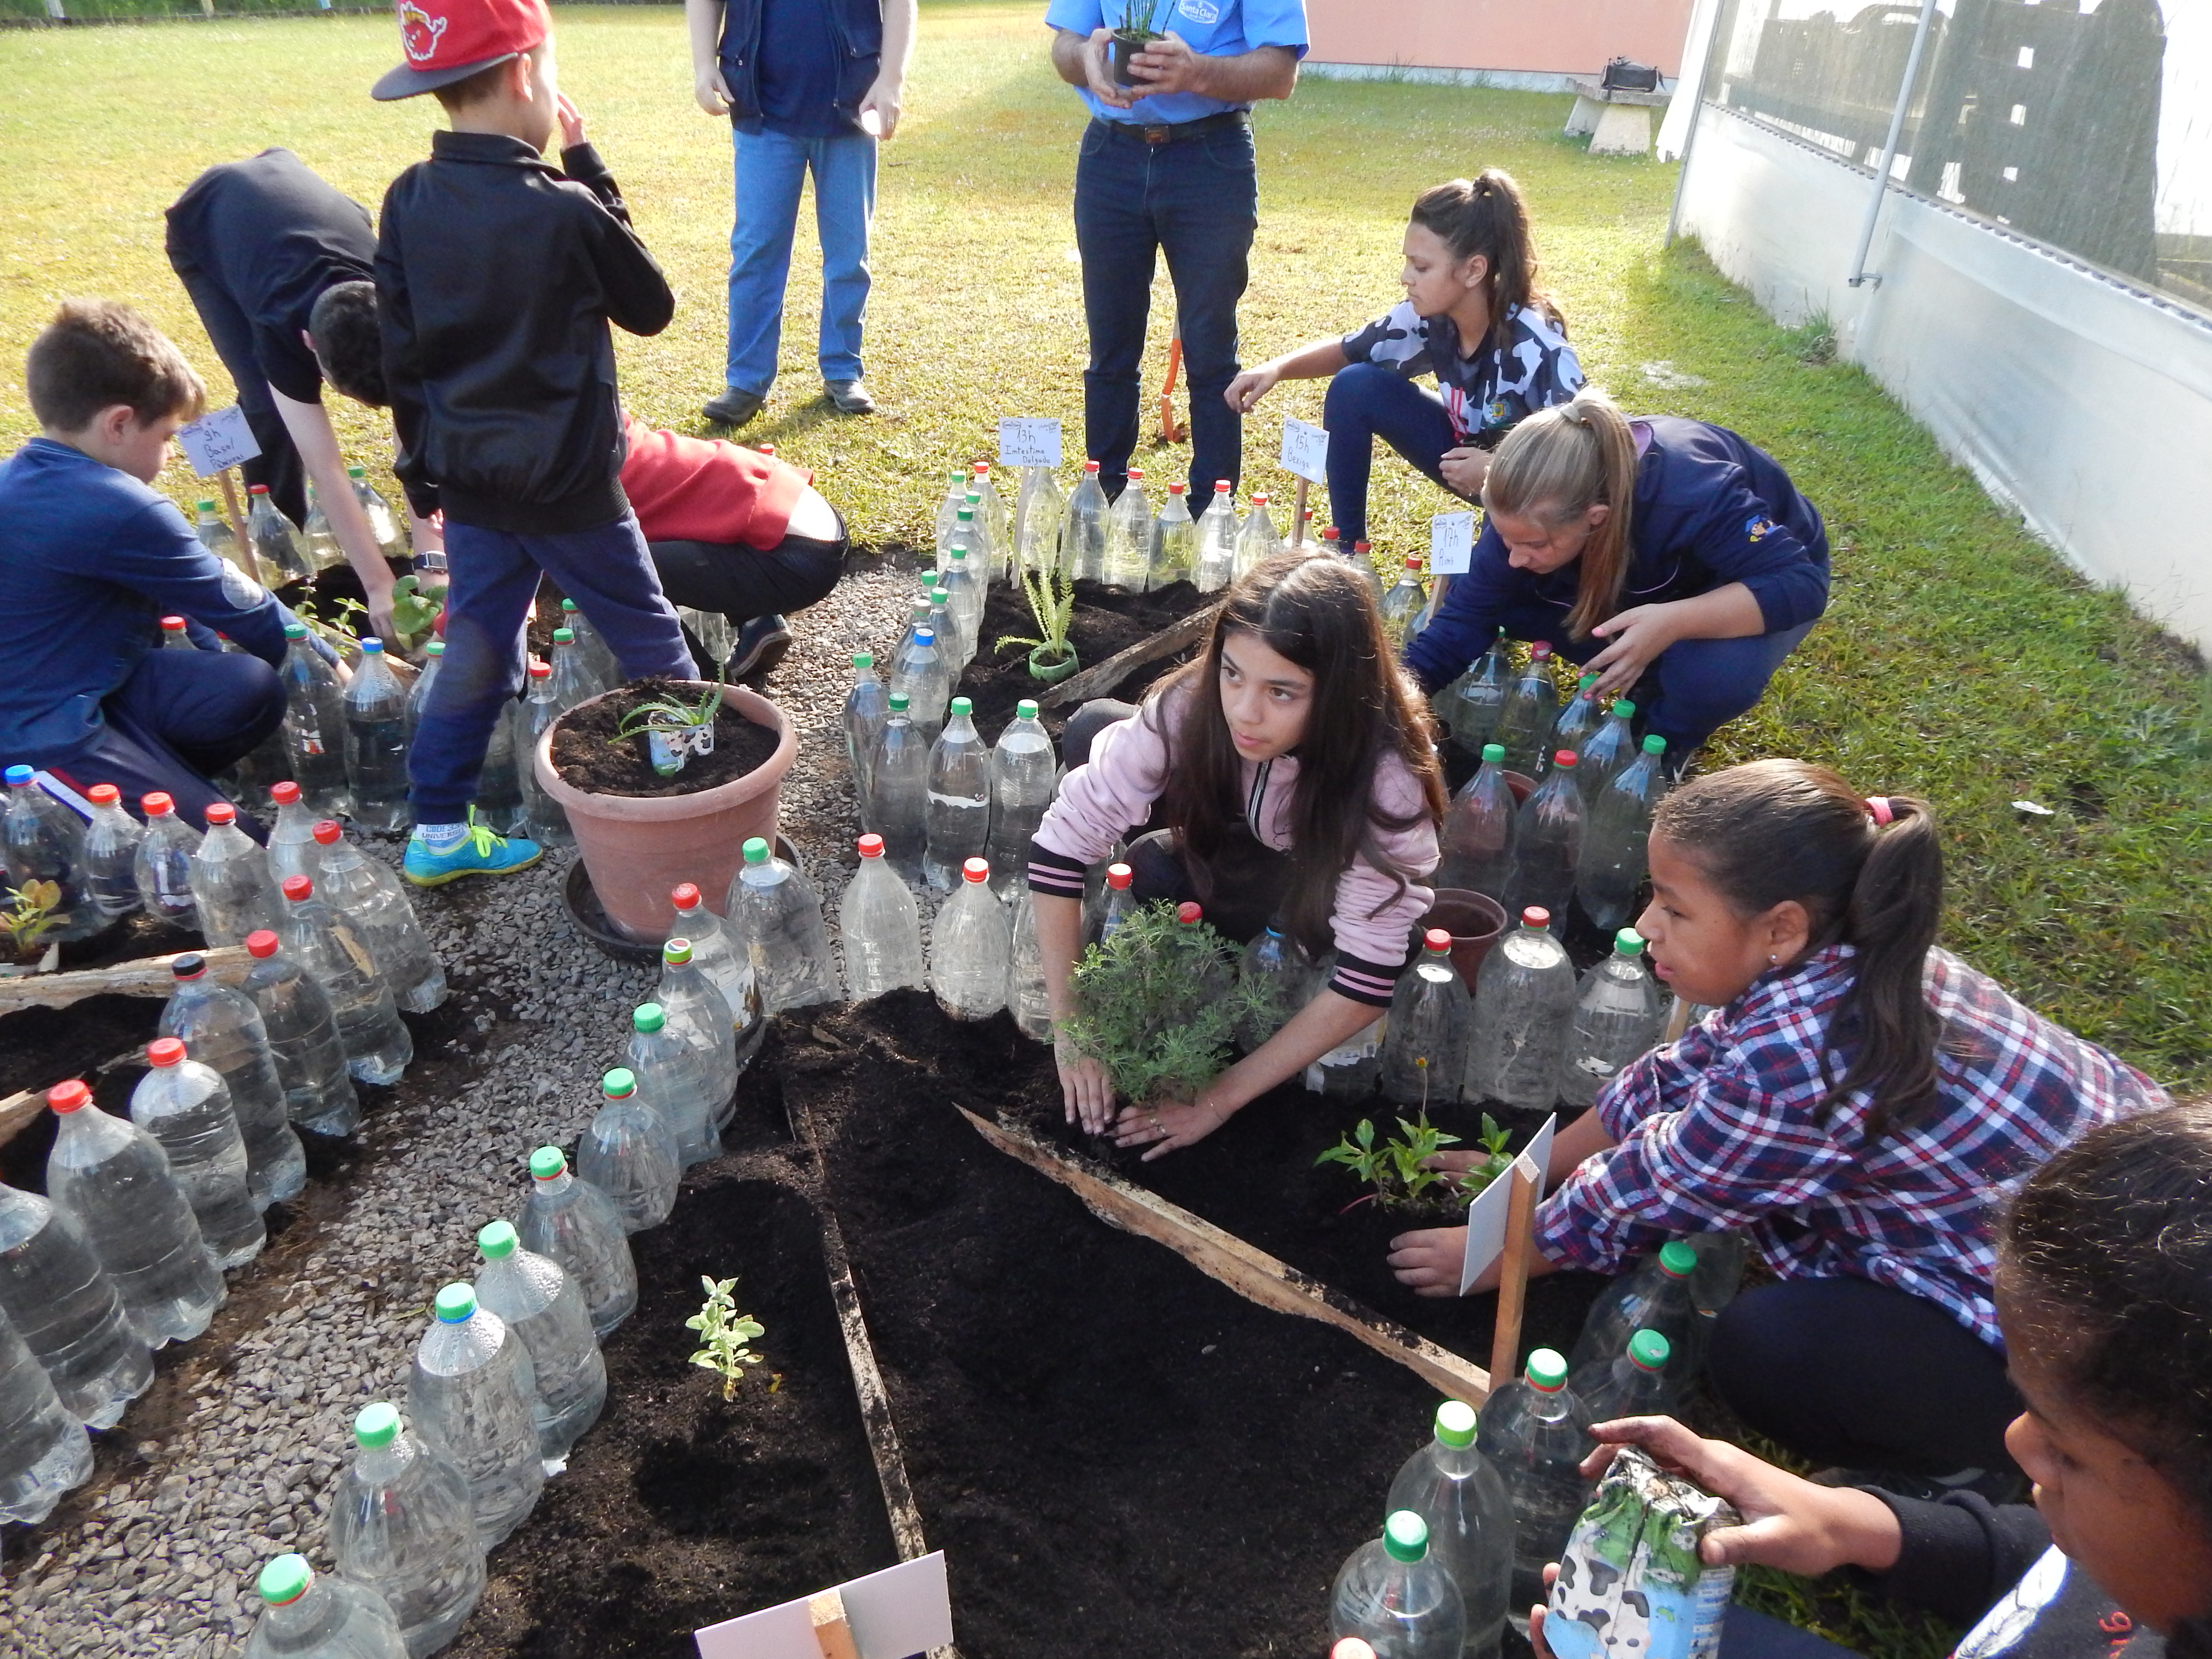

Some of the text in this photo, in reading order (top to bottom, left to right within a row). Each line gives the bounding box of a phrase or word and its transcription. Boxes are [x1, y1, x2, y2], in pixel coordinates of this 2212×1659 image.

[1181, 1, 1199, 15] Santa
[1200, 8, 1216, 19] Clara
[1017, 429, 1035, 444] 13h
[1296, 434, 1309, 453] 15h
[1022, 456, 1050, 465] Delgado
[1288, 446, 1310, 471] Bexiga
[1443, 528, 1458, 547] 17h
